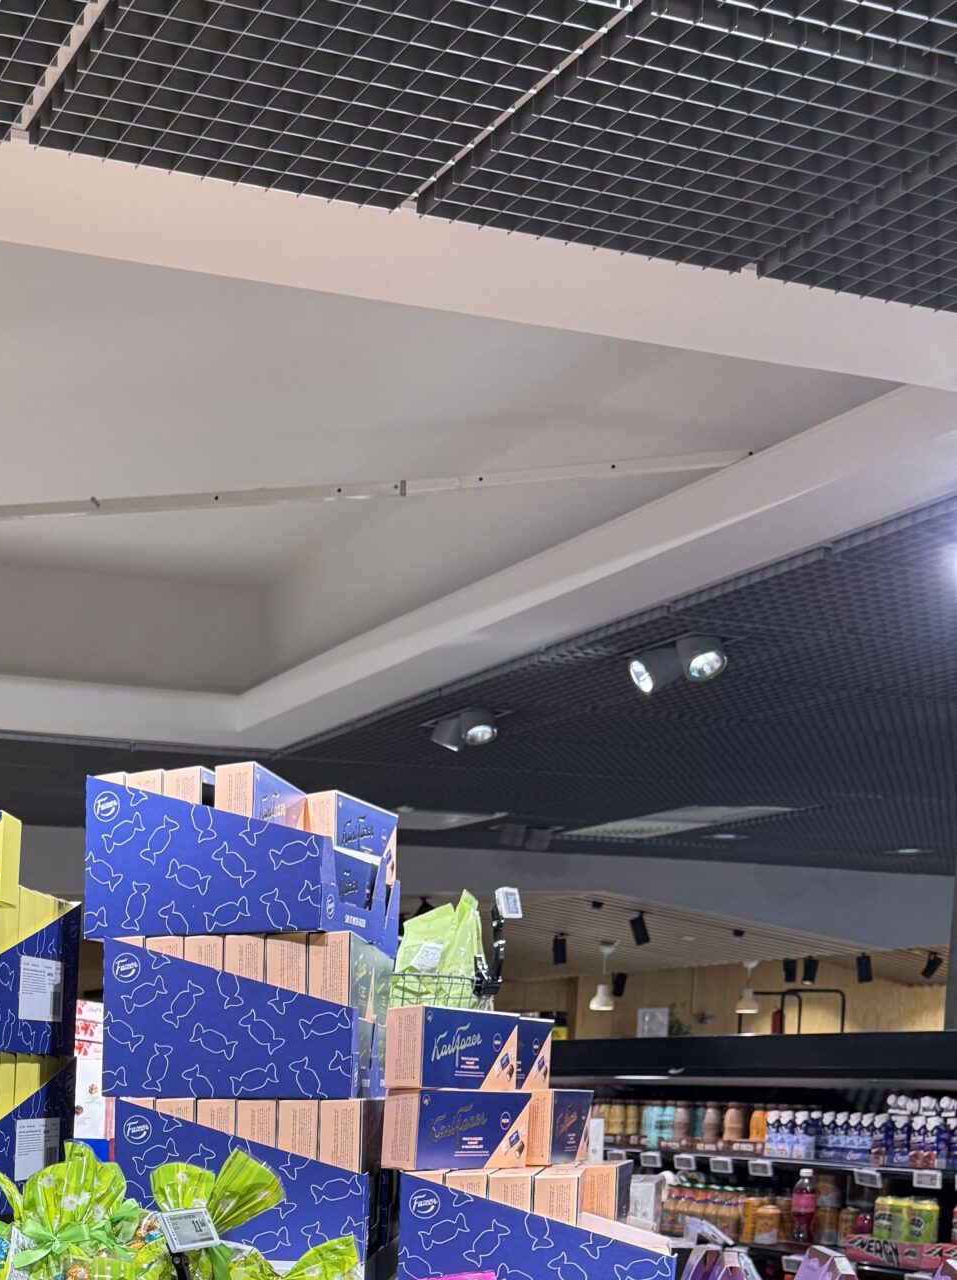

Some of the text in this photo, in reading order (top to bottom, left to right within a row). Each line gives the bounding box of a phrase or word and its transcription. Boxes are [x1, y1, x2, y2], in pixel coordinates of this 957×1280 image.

[97, 796, 117, 814] Fazer
[116, 958, 138, 975] Fazer
[431, 1022, 482, 1068] Karl Fazer
[127, 1121, 149, 1136] Fazer
[413, 1194, 437, 1211] Fazer
